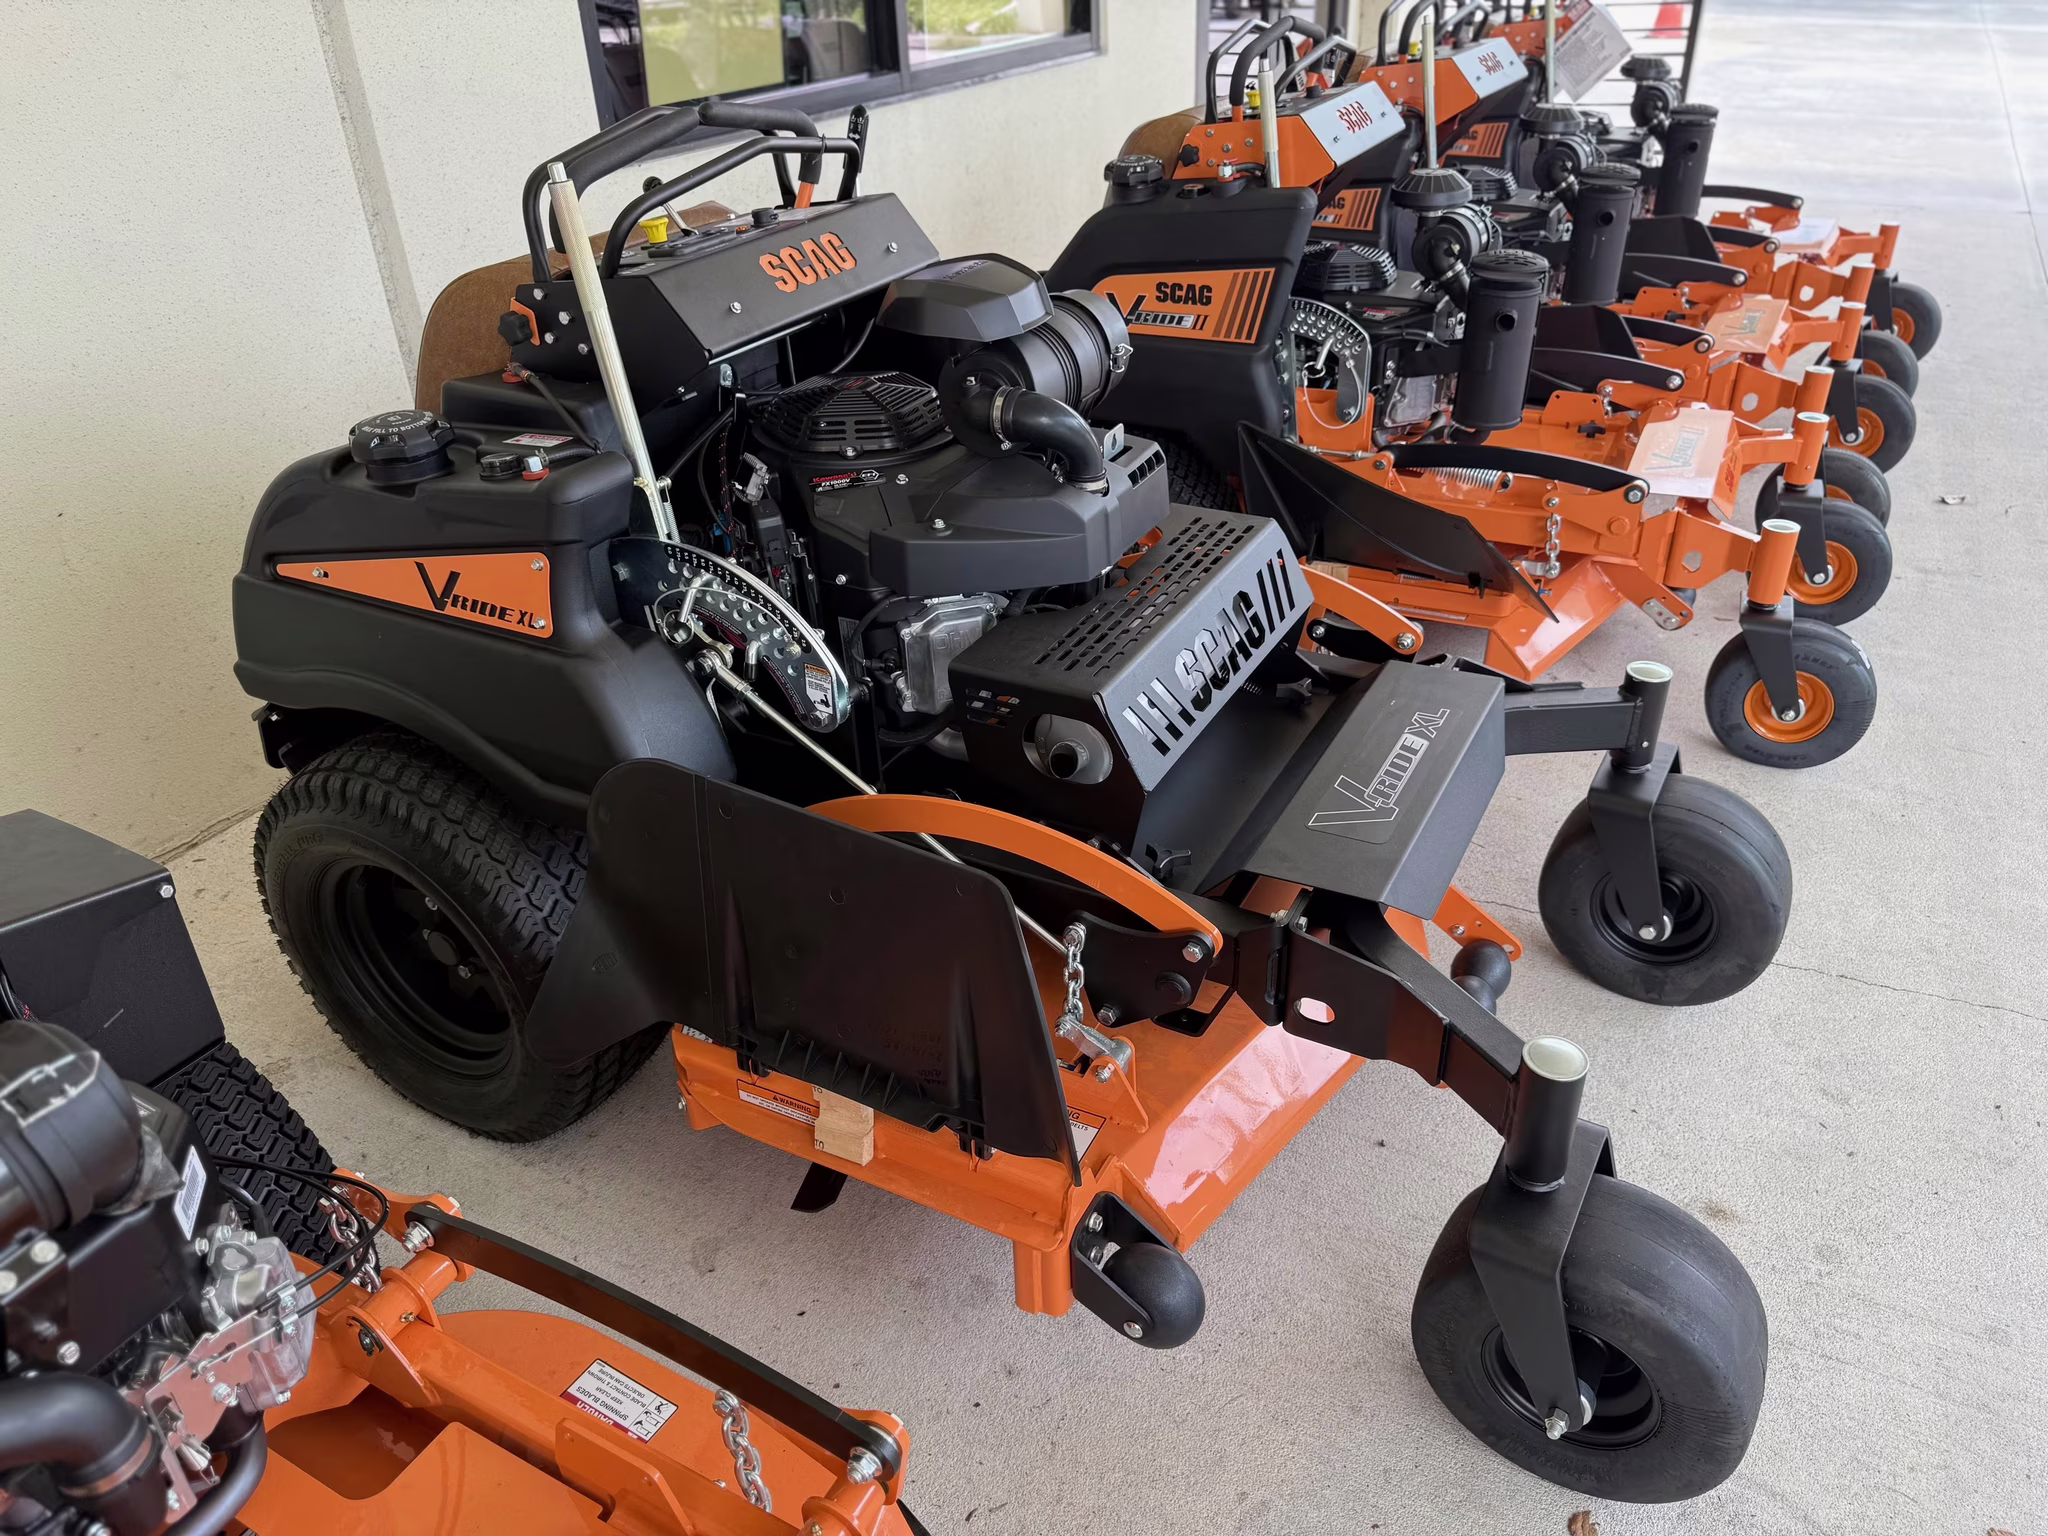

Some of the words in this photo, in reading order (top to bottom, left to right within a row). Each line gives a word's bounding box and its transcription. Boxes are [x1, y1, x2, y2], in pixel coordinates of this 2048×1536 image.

[1336, 101, 1373, 134] SCAG
[759, 232, 857, 293] SCAG
[1155, 281, 1212, 306] SCAG
[517, 609, 543, 630] XL
[1175, 590, 1266, 713] SCAG
[1404, 708, 1450, 738] XL
[779, 1097, 812, 1114] WARNING
[587, 1370, 606, 1384] THROWN
[598, 1368, 615, 1381] INJURE
[614, 1377, 625, 1387] CAN
[576, 1386, 601, 1404] BLADES
[595, 1386, 610, 1398] CLEAR
[609, 1395, 624, 1405] KEEP
[611, 1384, 632, 1400] CONTACT
[624, 1384, 646, 1399] OBJECTS
[600, 1401, 629, 1421] SPINNING
[633, 1397, 647, 1408] BLADE
